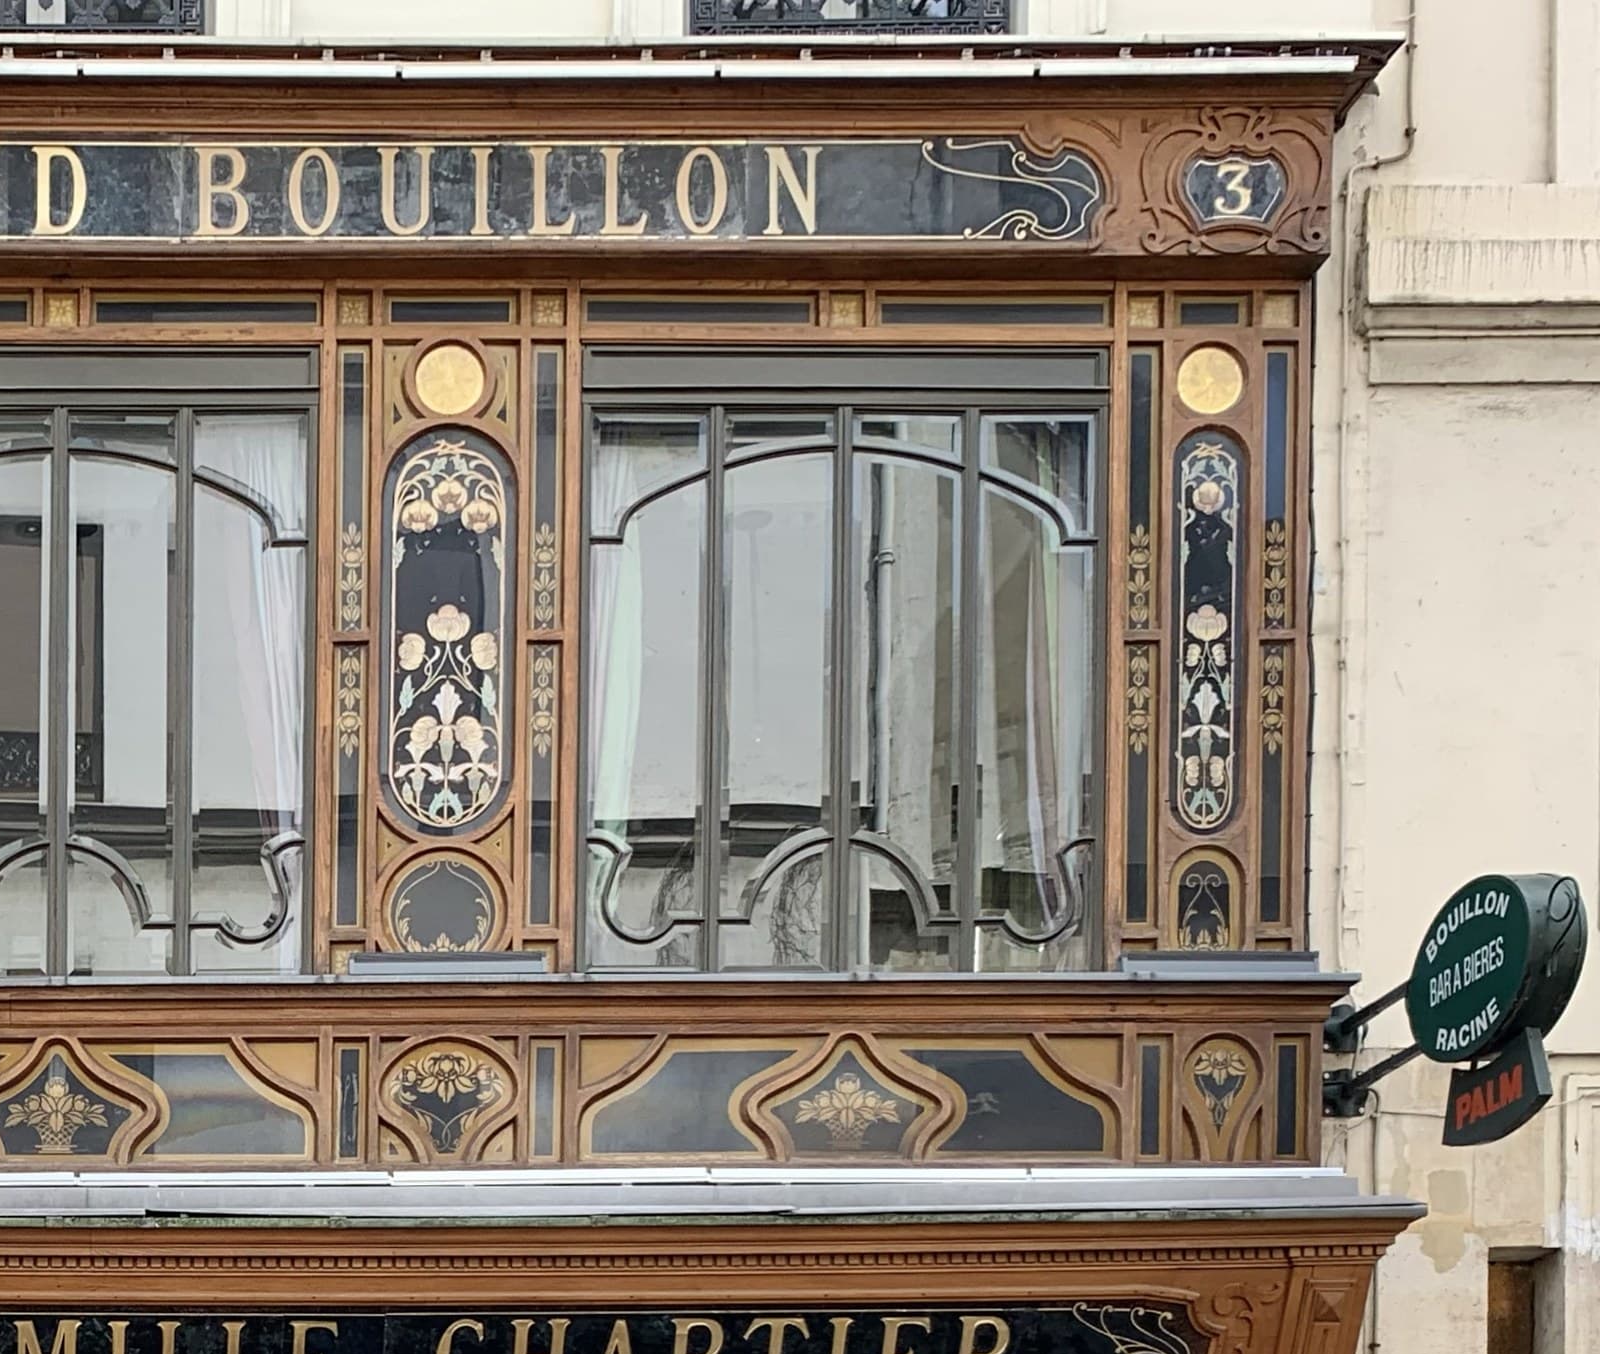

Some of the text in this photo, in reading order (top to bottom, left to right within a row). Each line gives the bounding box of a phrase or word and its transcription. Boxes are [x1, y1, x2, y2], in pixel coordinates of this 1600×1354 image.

[193, 142, 824, 237] BOUILLON
[1214, 162, 1252, 215] 3
[1425, 890, 1509, 963] BOUILLON
[1429, 935, 1505, 1008] BAR A BIERES
[1436, 997, 1500, 1051] RACINE
[1455, 1065, 1522, 1130] PALM
